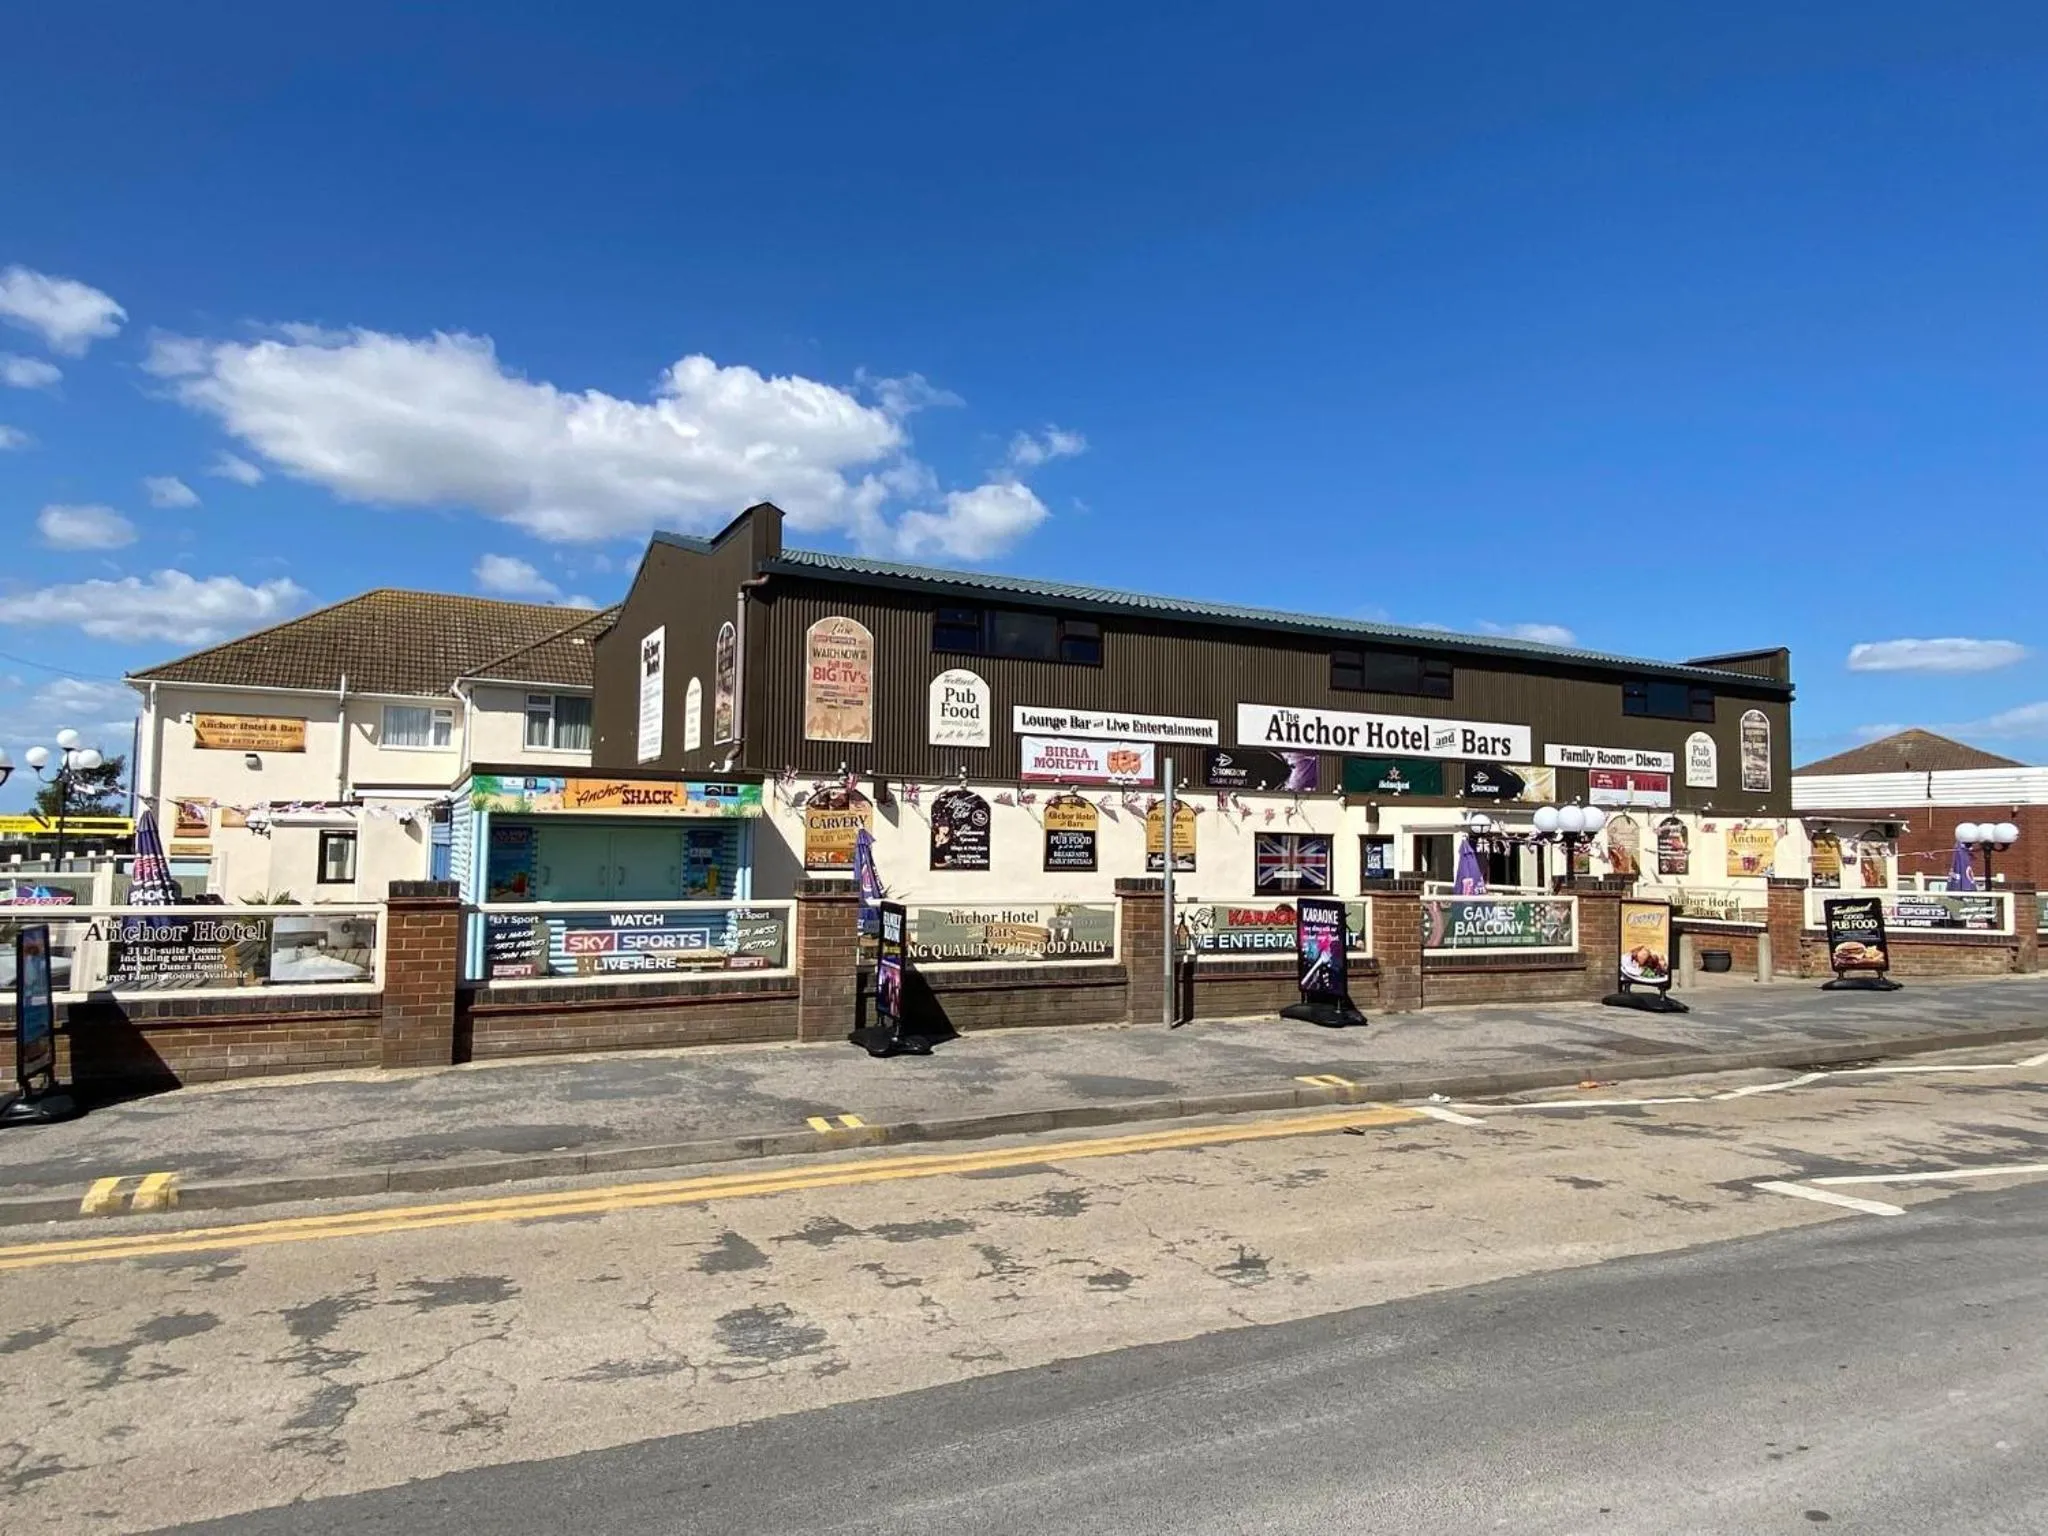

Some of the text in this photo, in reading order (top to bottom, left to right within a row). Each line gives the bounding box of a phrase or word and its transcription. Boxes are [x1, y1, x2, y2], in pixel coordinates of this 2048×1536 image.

[813, 647, 839, 658] WATCH
[841, 649, 860, 659] NOW
[813, 666, 867, 684] BIG TV's
[945, 687, 976, 704] Pub
[941, 702, 980, 719] Food
[1279, 710, 1300, 723] The
[200, 720, 237, 730] Anchor
[280, 724, 304, 732] Bars
[1021, 712, 1067, 730] Lounge
[1070, 715, 1091, 730] Bar
[1106, 718, 1130, 733] Live
[1132, 720, 1214, 738] Entertainment
[1266, 713, 1512, 756] Anchor Hotel and Bars
[1045, 746, 1090, 759] BIRRA
[1692, 744, 1710, 756] Pub
[1034, 757, 1098, 771] MORETTI
[1560, 748, 1595, 766] Family
[1597, 751, 1626, 765] Room
[1636, 754, 1662, 768] Disco
[1691, 756, 1712, 768] Food
[577, 784, 631, 806] Anchor
[622, 790, 674, 805] SHACK
[810, 814, 868, 829] CARVERY
[1050, 836, 1092, 844] PUB FOOD
[1730, 832, 1770, 845] Anchor
[1708, 896, 1740, 909] Hotel
[747, 911, 770, 920] Sport
[945, 910, 1039, 925] Anchor Hotel
[1302, 907, 1339, 925] KARAOKE
[1463, 906, 1516, 920] GAMES
[1899, 906, 1946, 916] SPORTS
[512, 916, 538, 925] Sport
[610, 914, 664, 926] WATCH
[1832, 920, 1878, 930] PUB FOOD
[84, 920, 267, 942] Anchor Hotel
[984, 924, 1017, 938] Bars
[1455, 920, 1524, 936] BALCONY
[568, 936, 610, 950] SKY
[622, 934, 701, 950] SPORTS
[742, 938, 778, 951] ACTION
[127, 946, 222, 955] 31 En-suite Rooms
[932, 944, 993, 960] QUALITY
[1030, 940, 1066, 954] FOOD
[1072, 940, 1107, 954] DAILY
[192, 954, 228, 963] Luxury
[594, 956, 678, 970] LIVE HERE
[730, 956, 764, 968] ESPN
[118, 964, 156, 972] Anchor
[194, 962, 228, 970] Rooms
[492, 964, 534, 976] ESPN
[204, 970, 248, 978] Available
